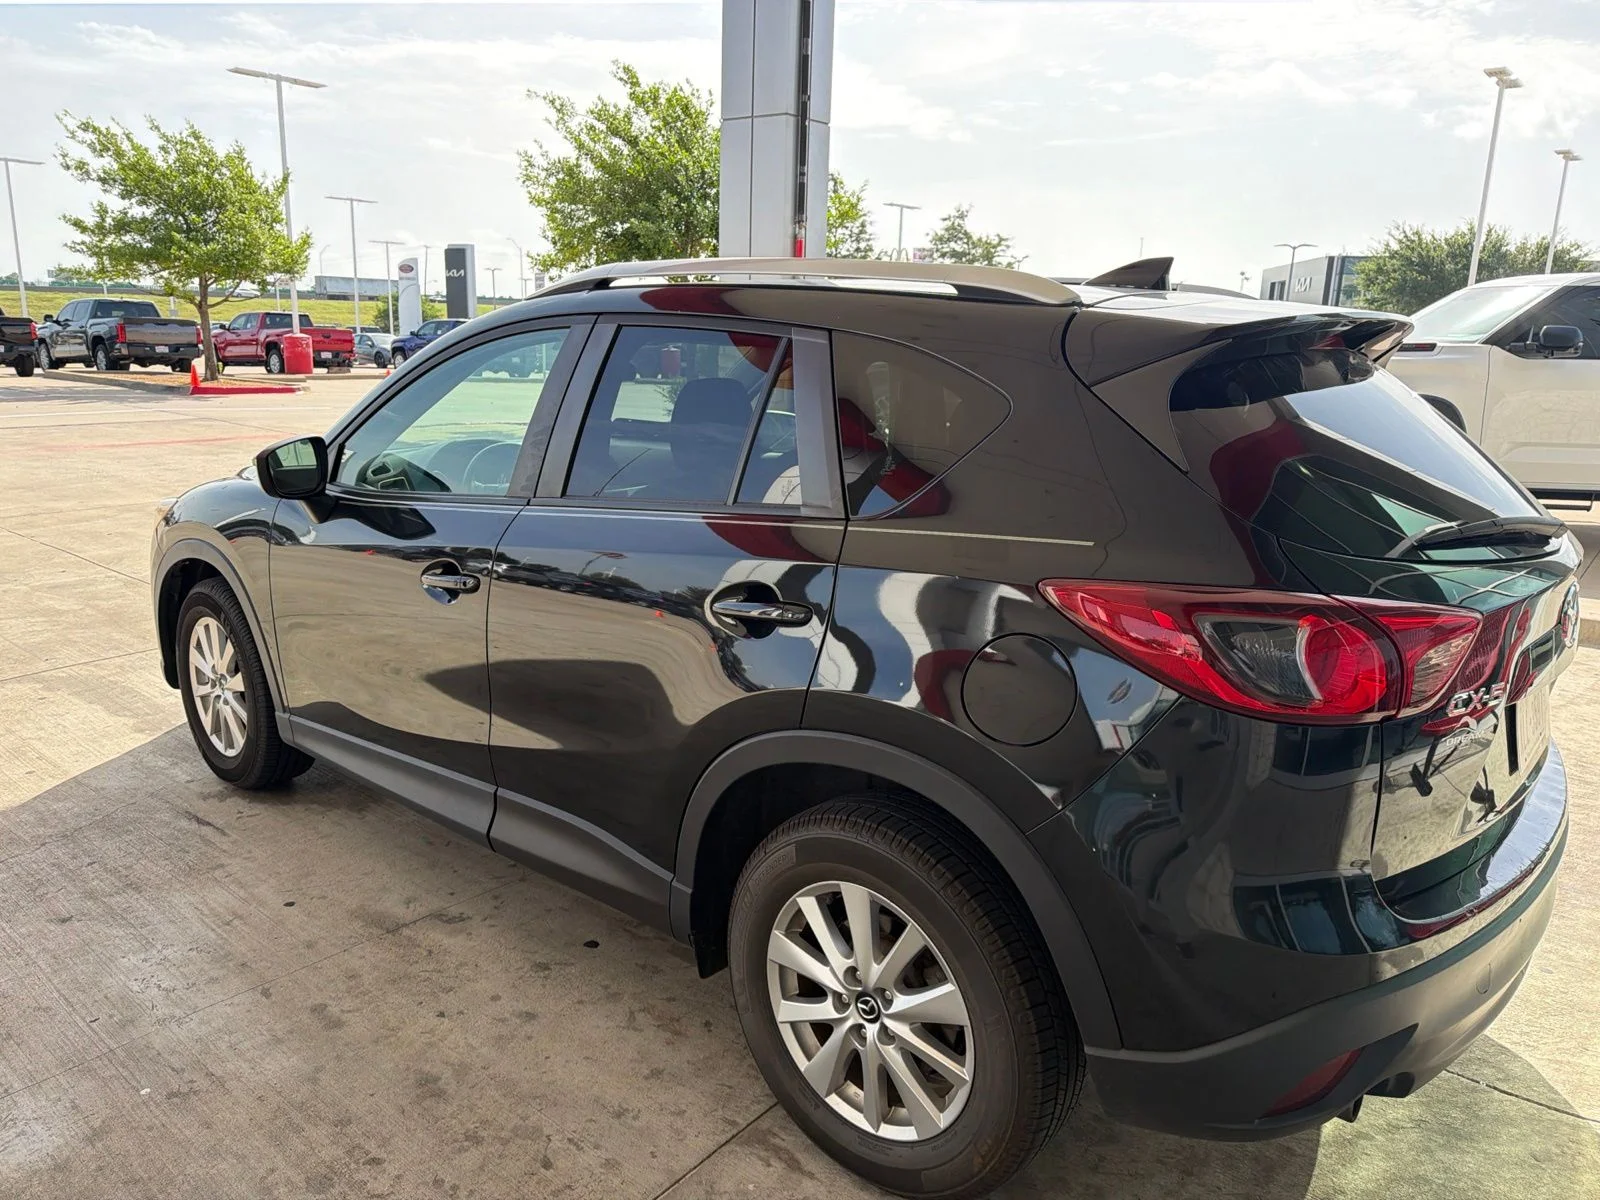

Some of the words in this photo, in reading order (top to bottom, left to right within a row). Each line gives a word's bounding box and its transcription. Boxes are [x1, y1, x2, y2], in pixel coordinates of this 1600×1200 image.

[446, 269, 465, 277] KIA
[1294, 276, 1312, 292] KIA
[1446, 682, 1505, 717] CX-5
